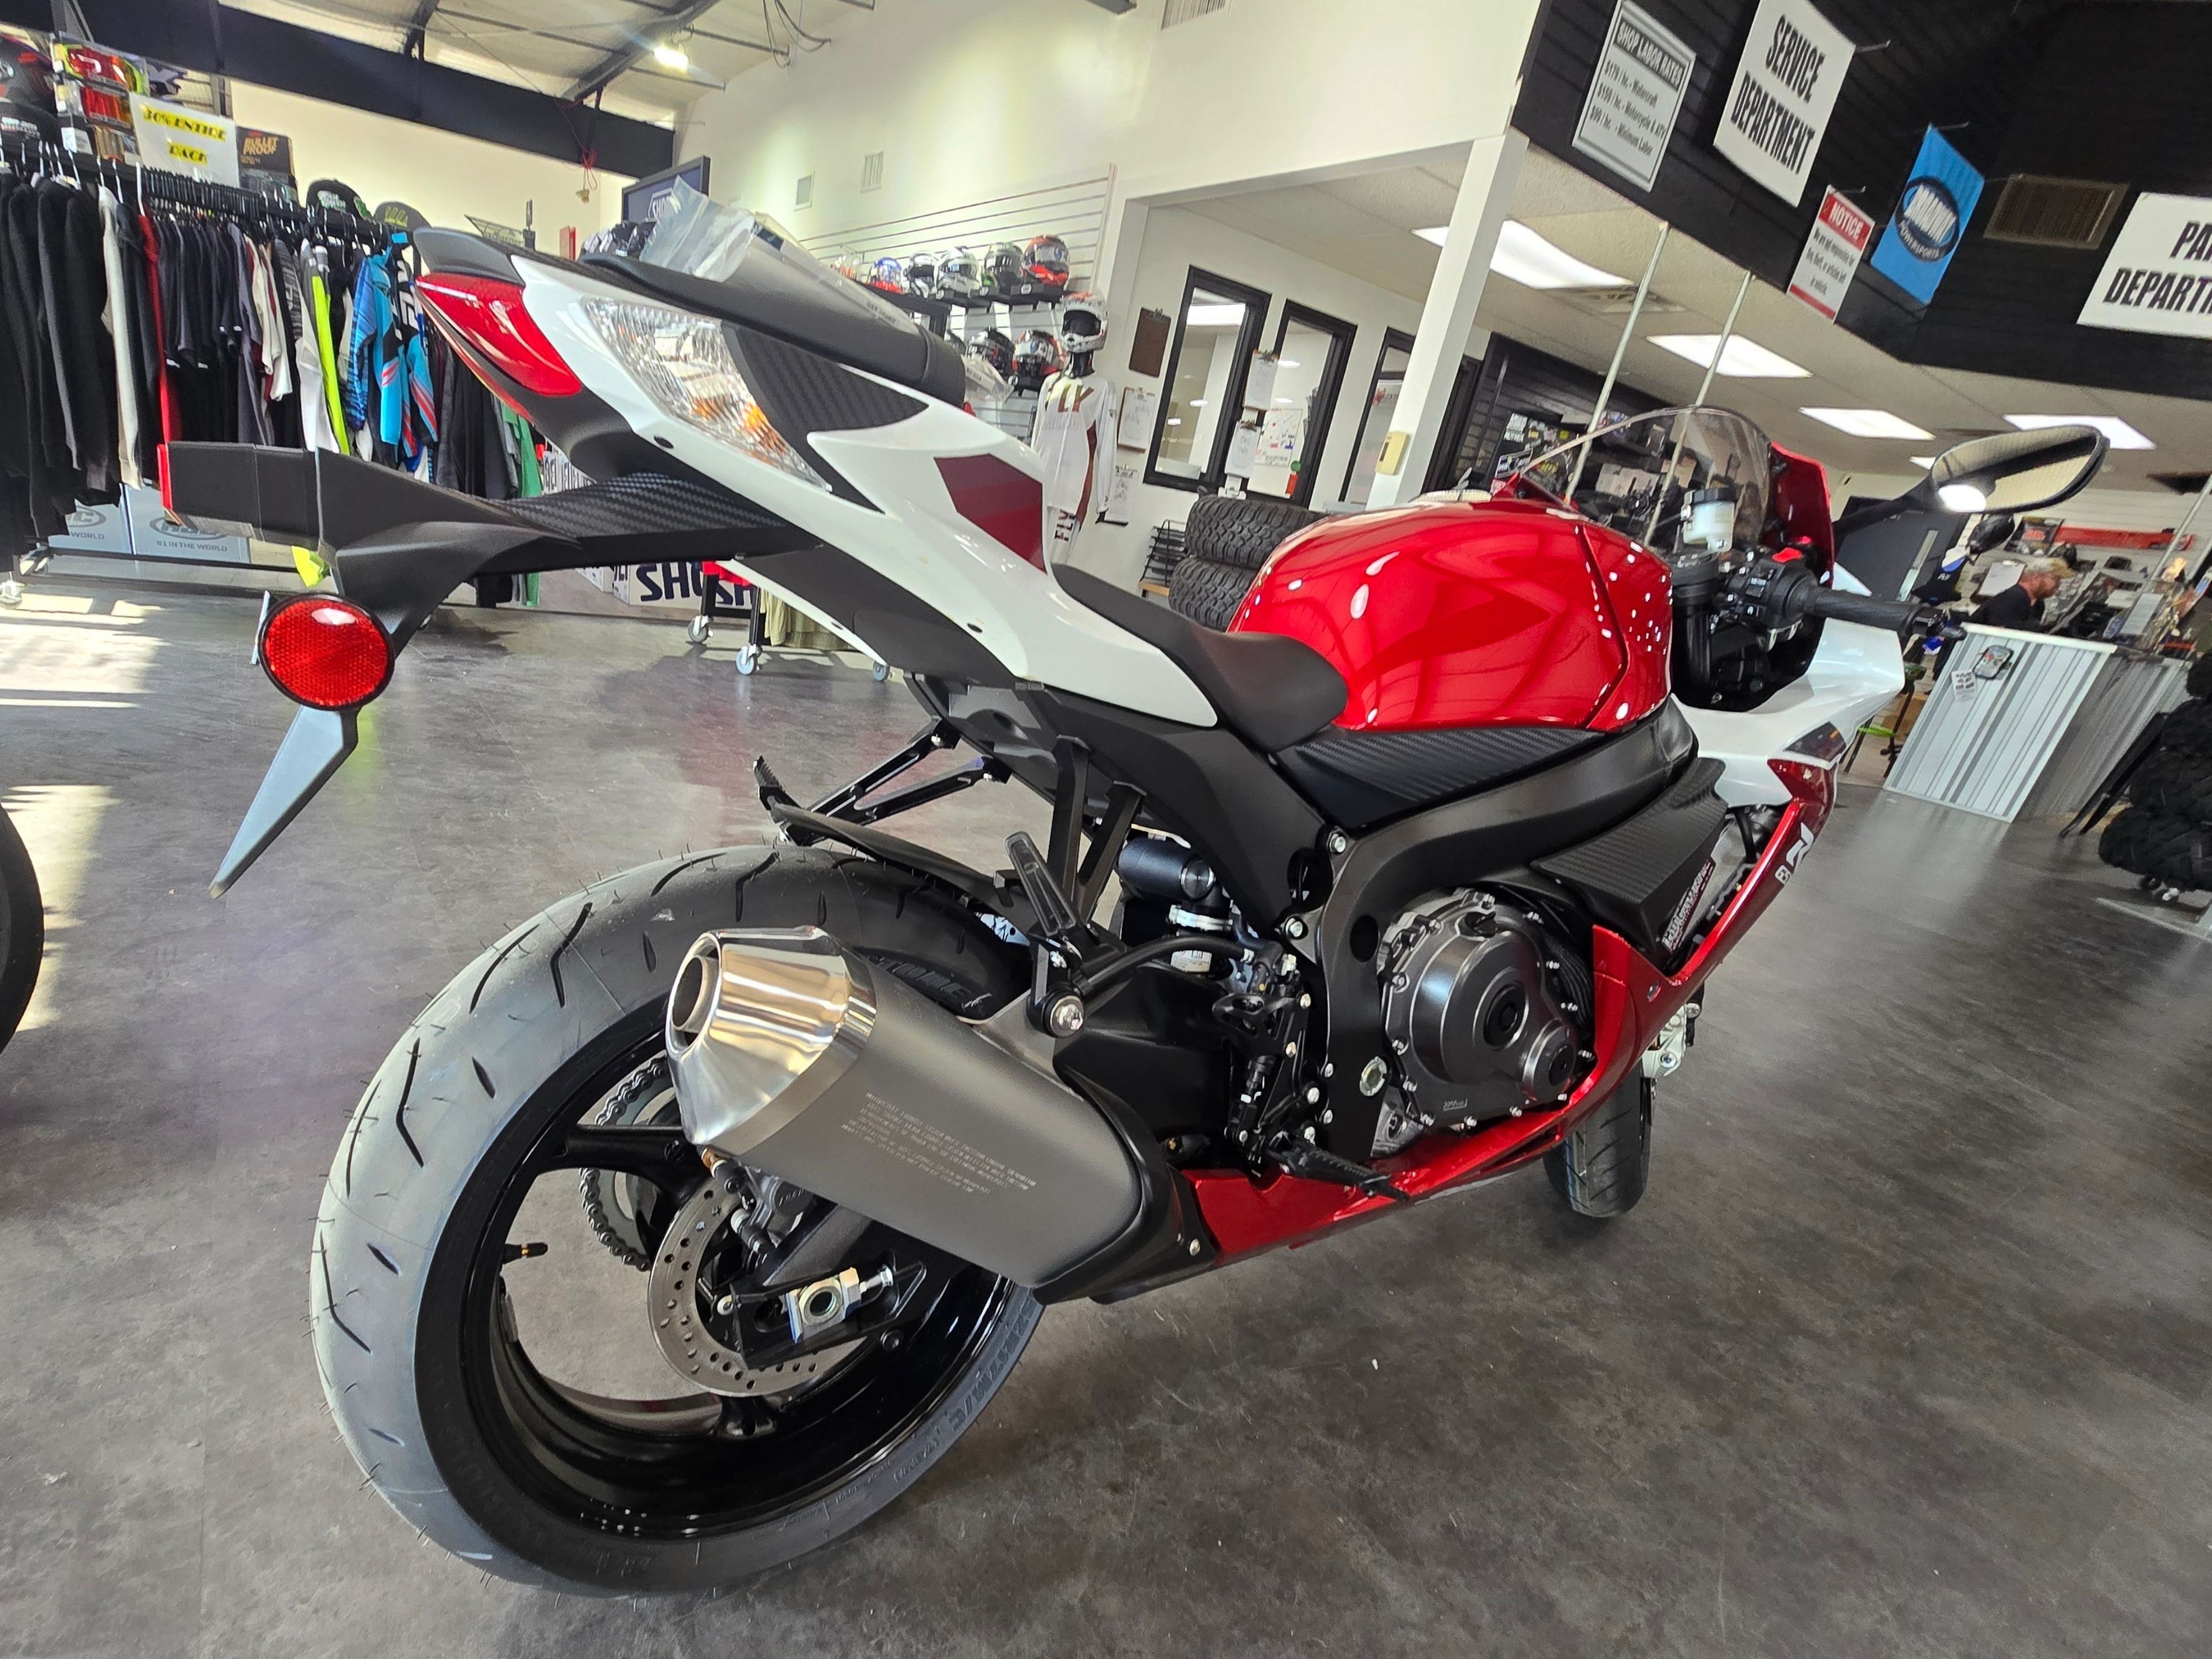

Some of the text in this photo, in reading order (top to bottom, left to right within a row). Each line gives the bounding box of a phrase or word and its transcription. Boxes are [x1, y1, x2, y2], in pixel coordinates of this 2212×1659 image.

[1617, 21, 1683, 88] SHOP LABOR RATES
[1766, 14, 1825, 105] SERVICE
[1632, 79, 1658, 108] Watercraft
[174, 117, 227, 141] ENTIRE
[1625, 100, 1651, 130] Motorcycle
[1654, 122, 1666, 140] ATV
[1730, 70, 1816, 175] DEPARTMENT
[1828, 201, 1864, 241] NOTICE
[70, 531, 104, 540] WORLD
[197, 544, 227, 552] WORLD
